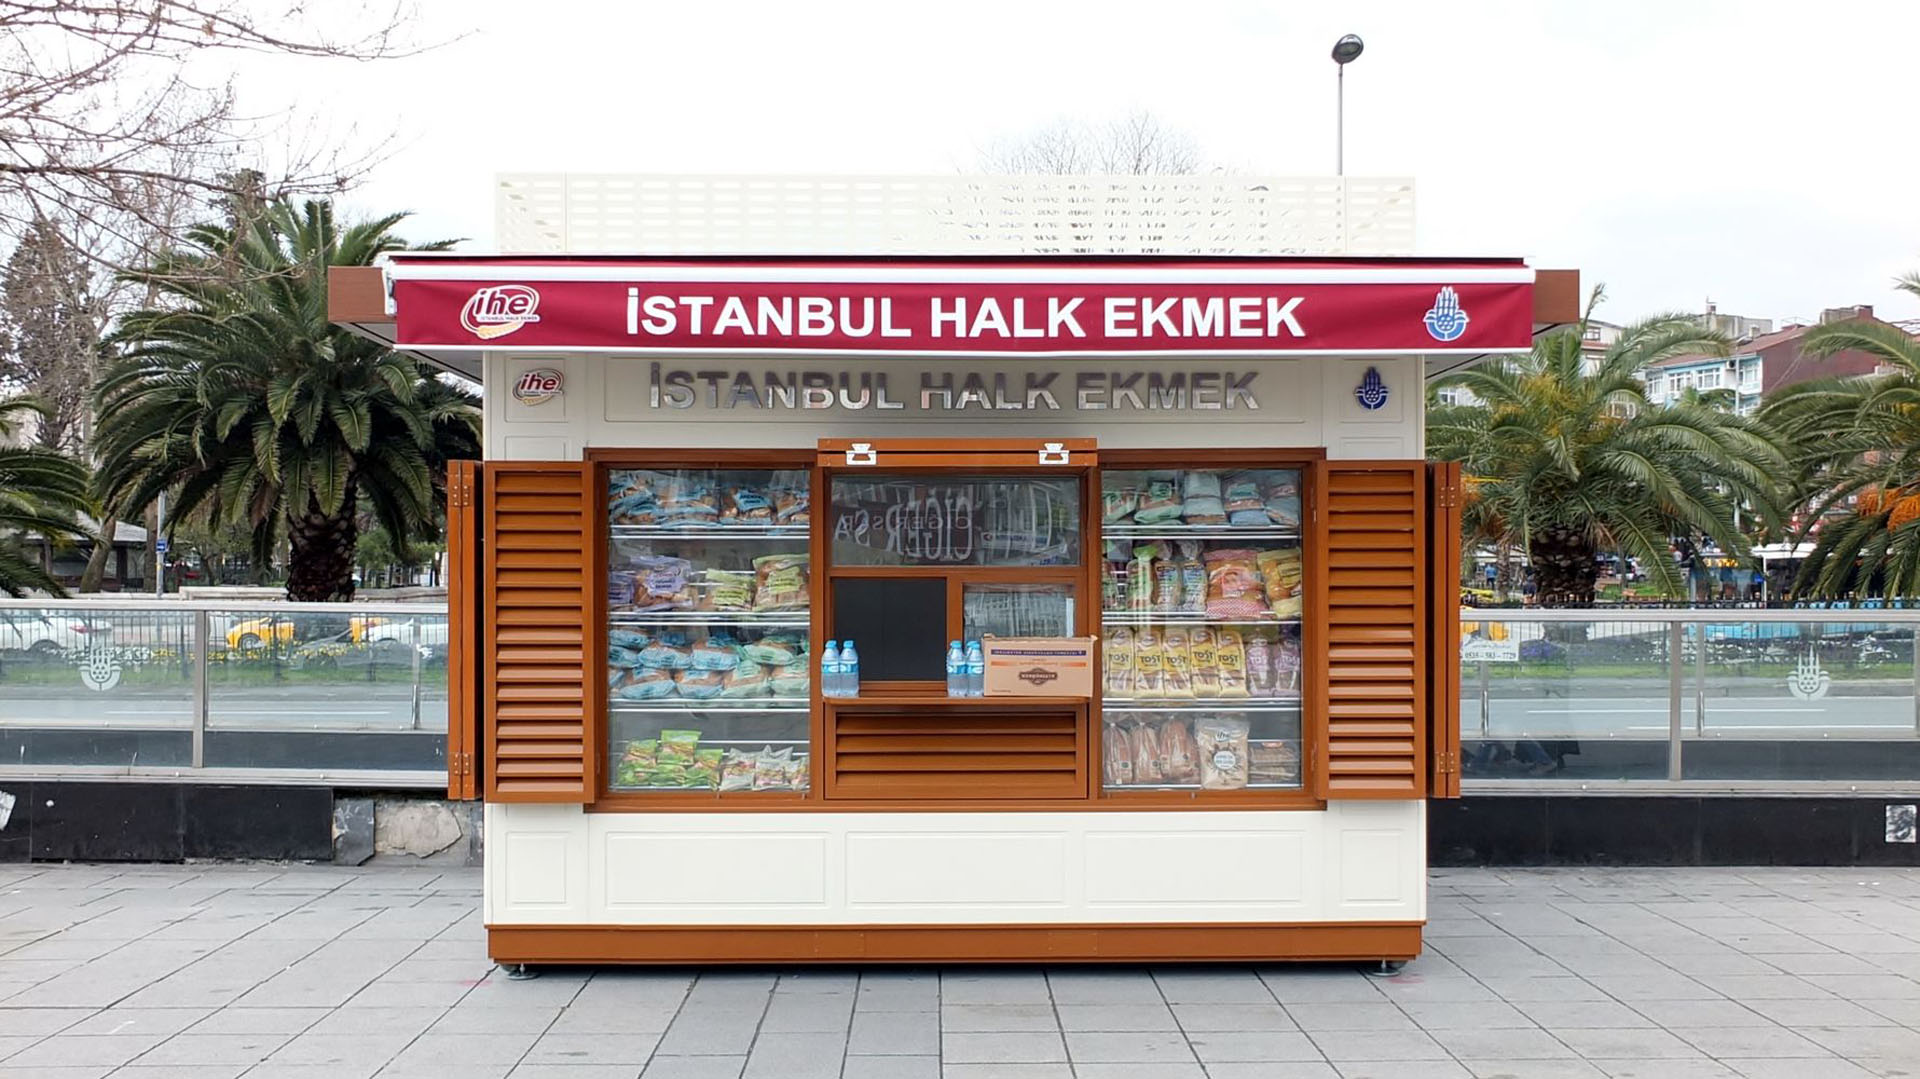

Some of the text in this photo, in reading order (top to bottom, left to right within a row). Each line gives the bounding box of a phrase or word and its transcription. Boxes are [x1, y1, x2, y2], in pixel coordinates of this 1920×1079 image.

[474, 289, 530, 316] ihe
[626, 287, 1305, 338] İSTANBUL HALK EKMEK
[520, 373, 557, 391] ihe
[650, 361, 1260, 410] İSTANBUL HALK EKMEK
[1140, 655, 1161, 664] TOST
[1192, 651, 1214, 660] TOST
[1218, 654, 1238, 663] TOST
